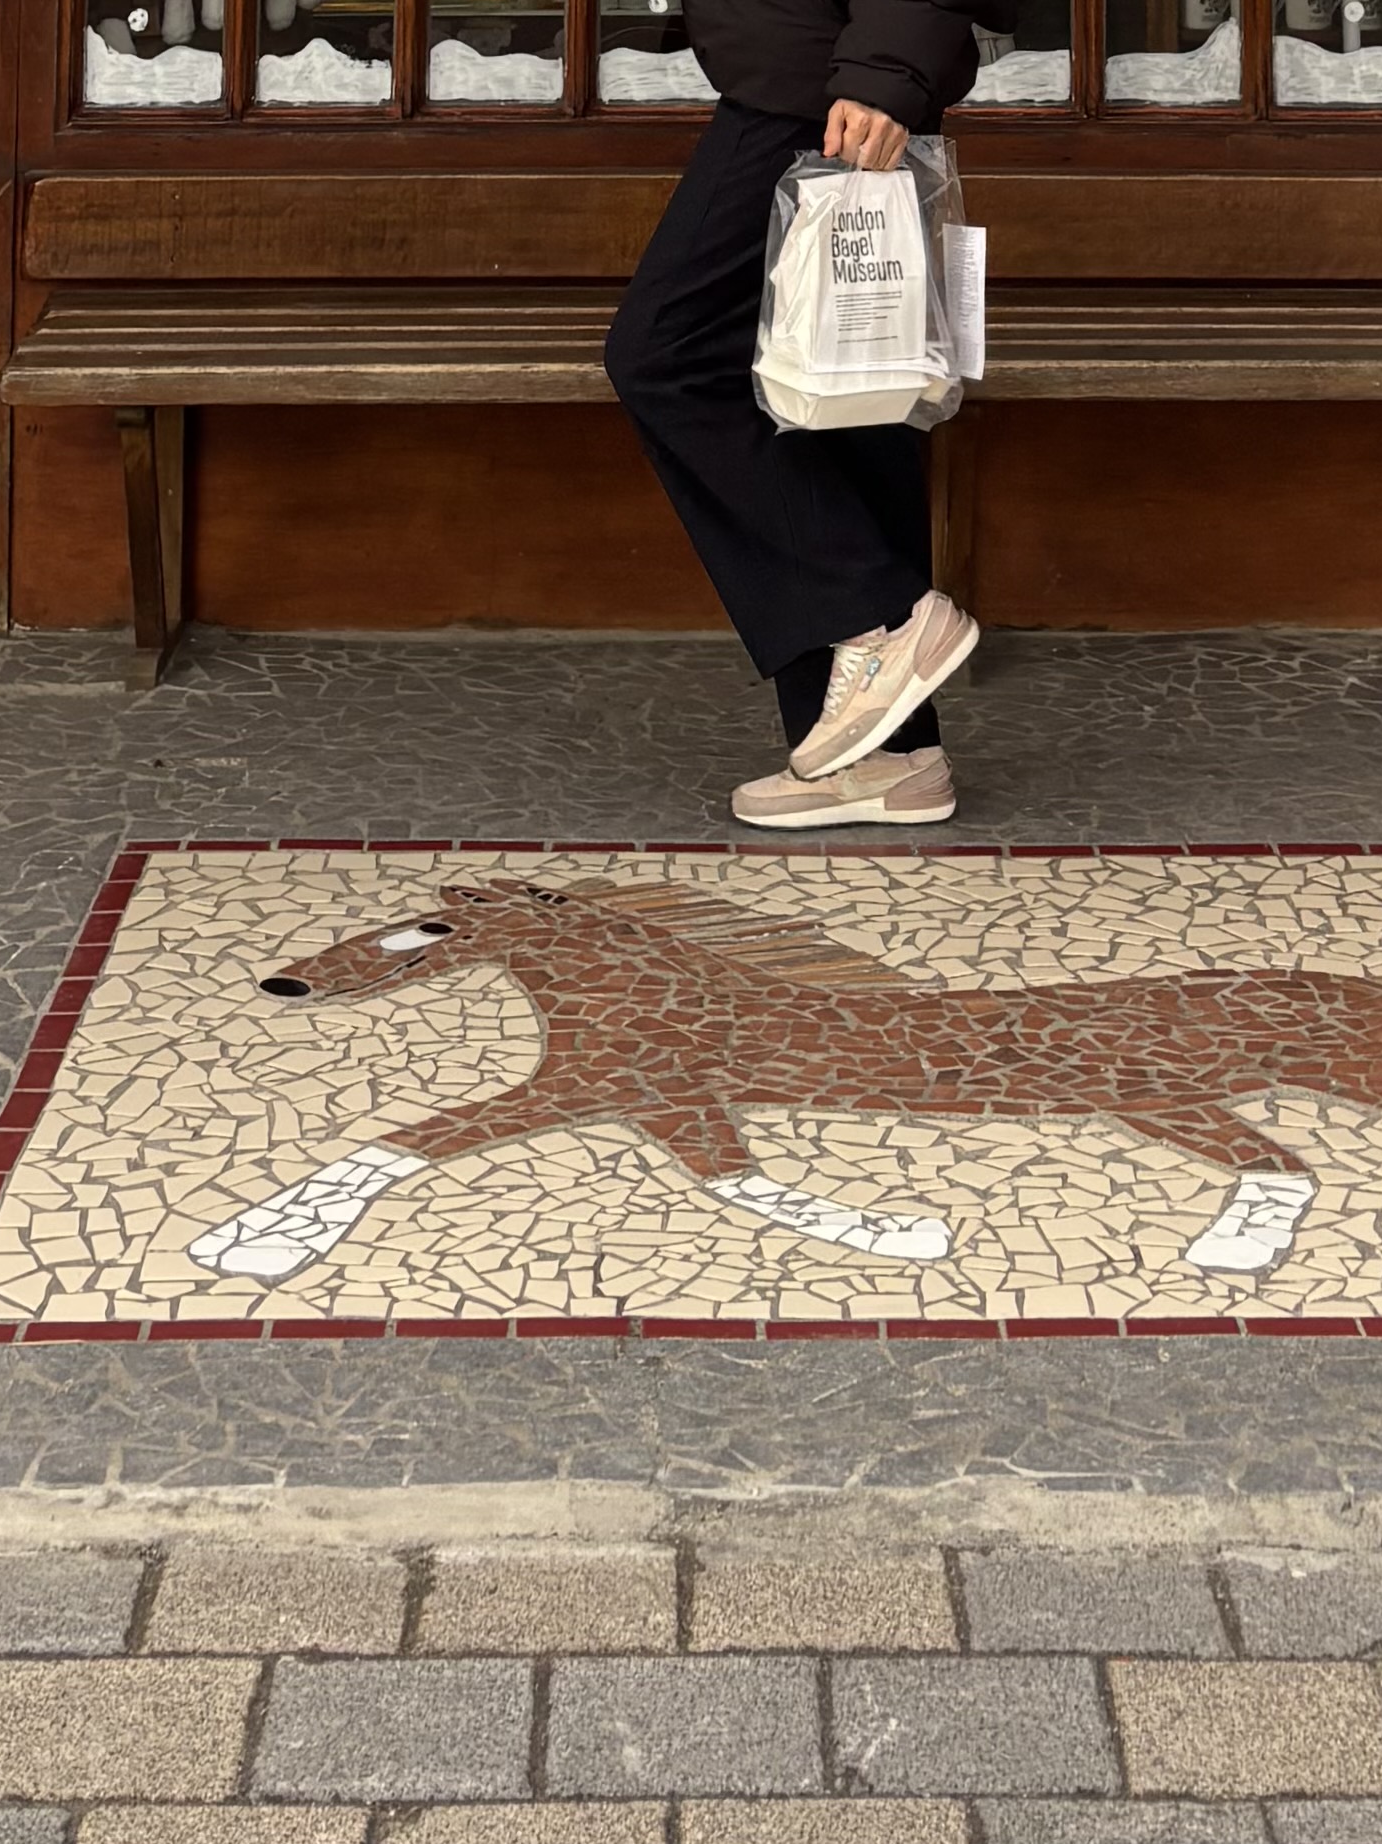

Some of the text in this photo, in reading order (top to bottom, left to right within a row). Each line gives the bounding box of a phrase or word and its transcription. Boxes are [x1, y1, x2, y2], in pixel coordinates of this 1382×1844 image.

[831, 205, 885, 232] London
[831, 231, 875, 262] Bagel
[832, 259, 904, 284] Museum
